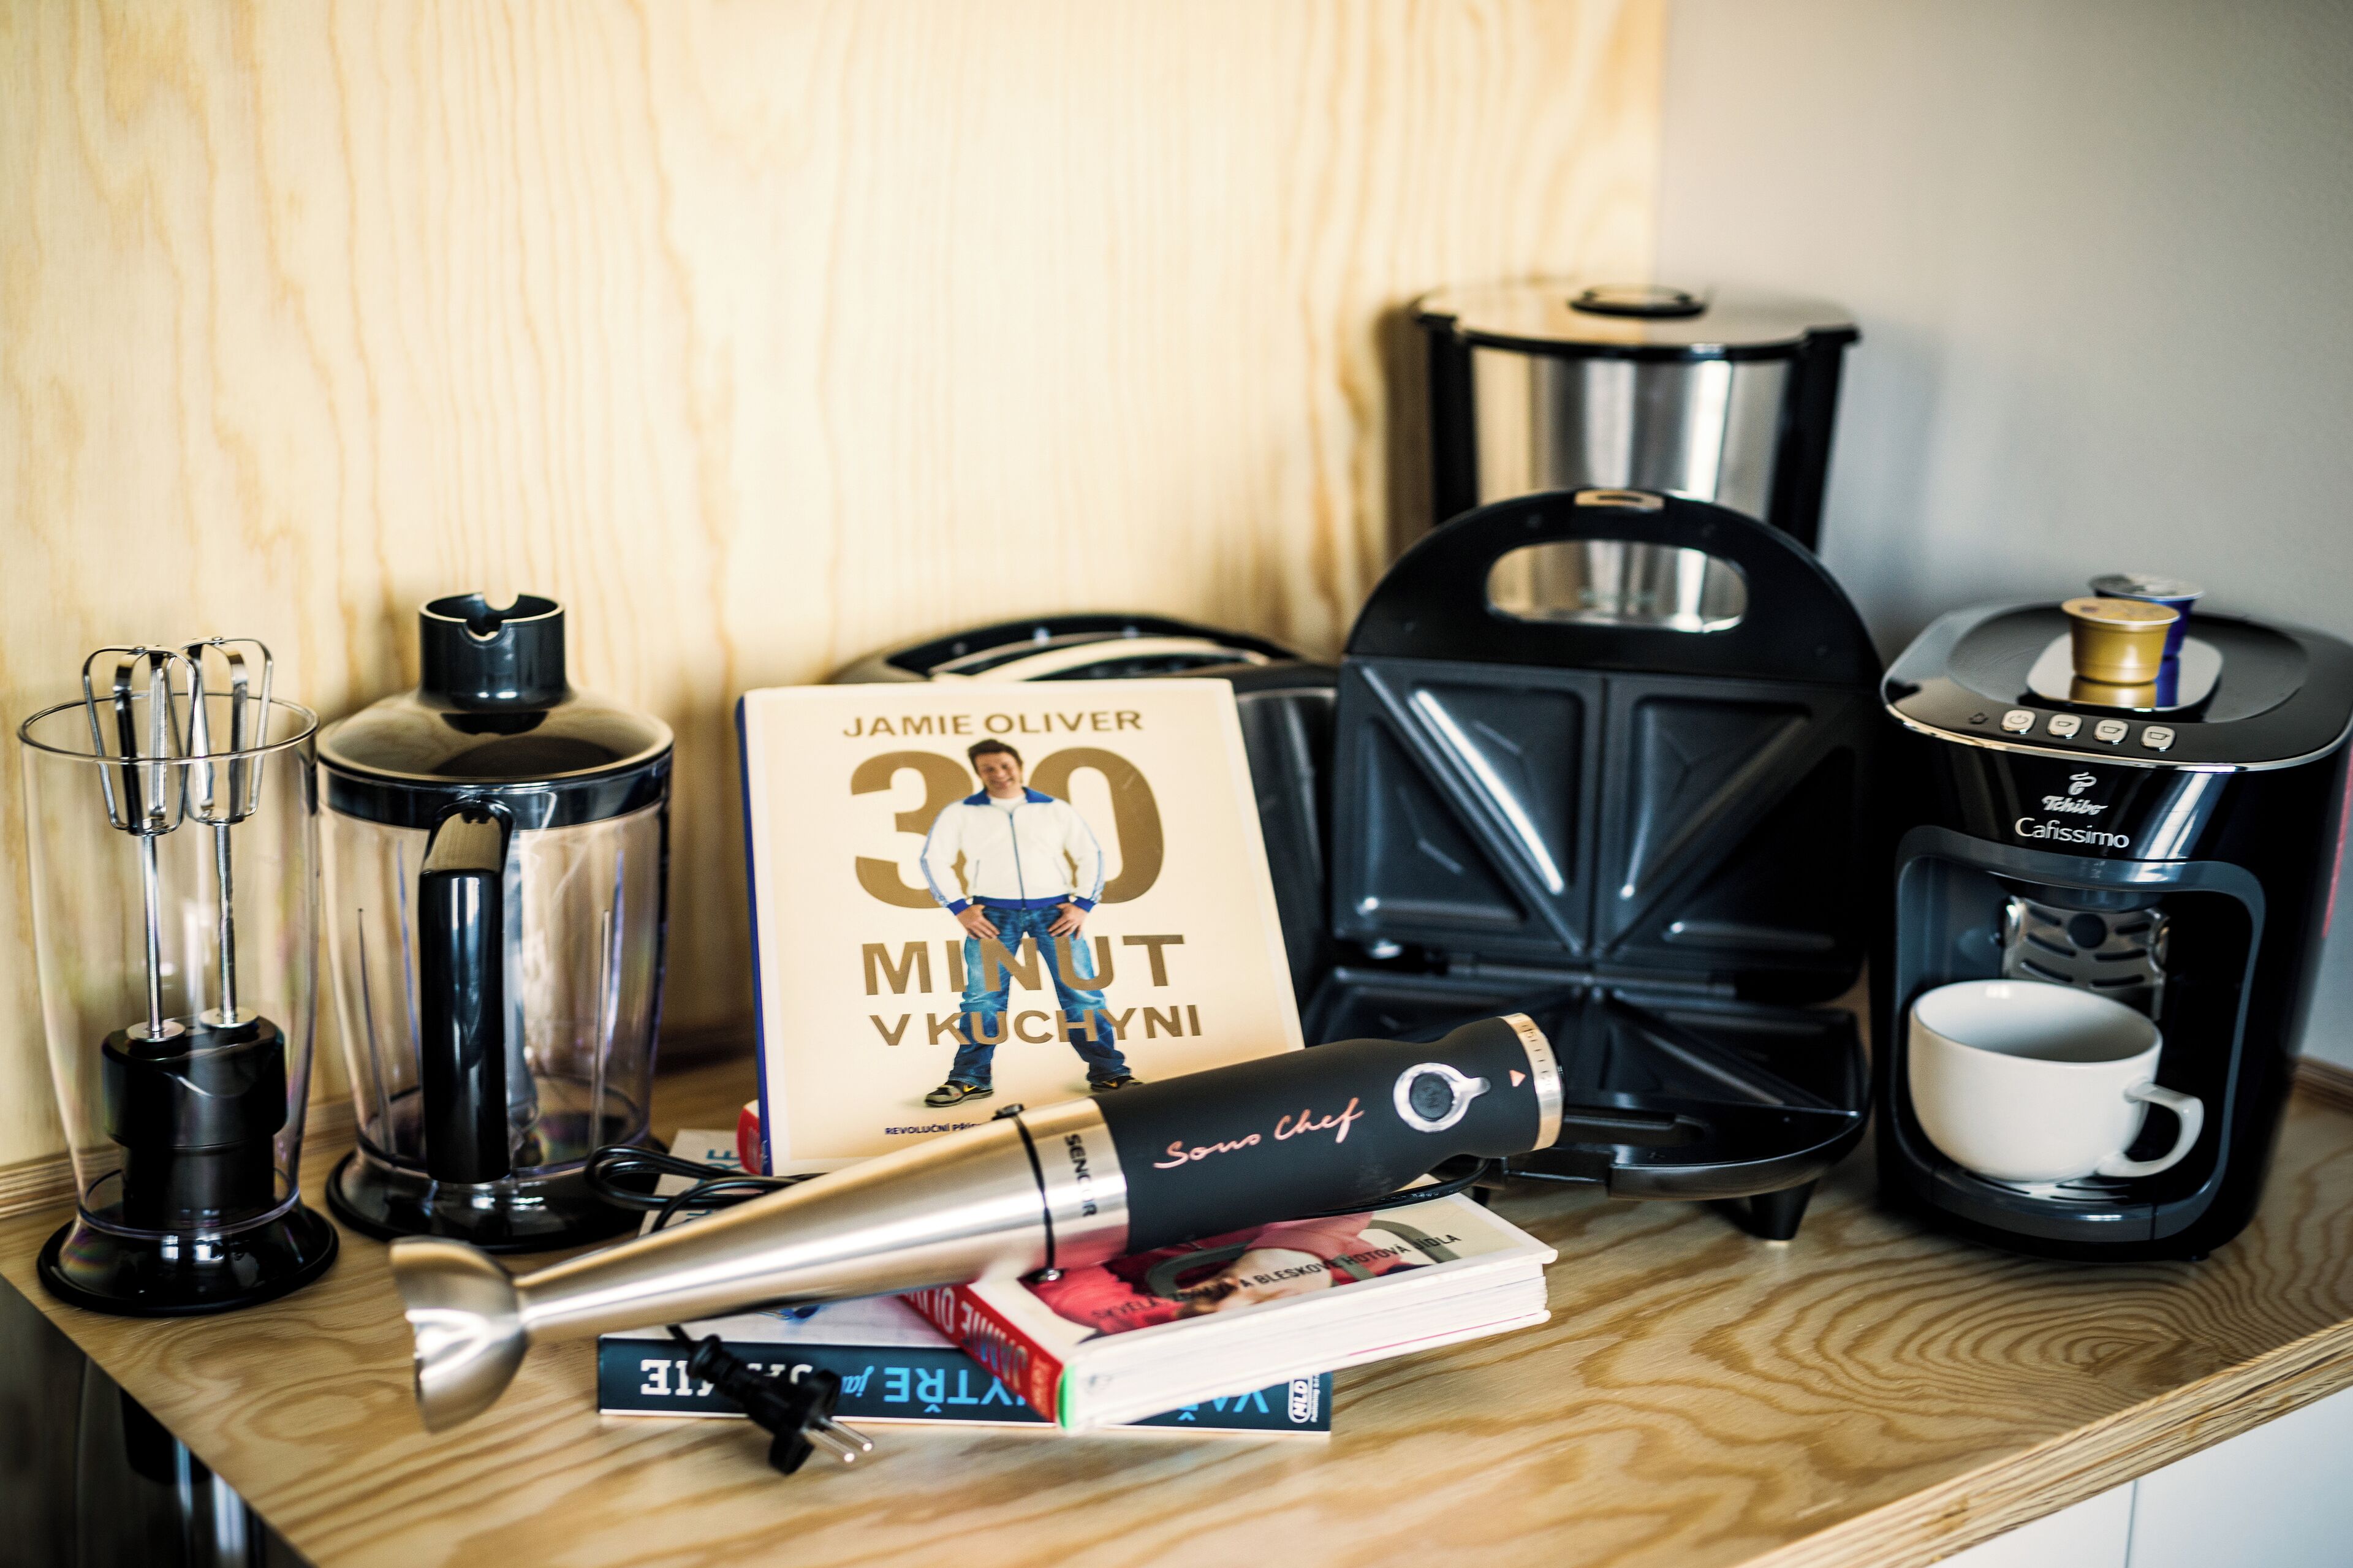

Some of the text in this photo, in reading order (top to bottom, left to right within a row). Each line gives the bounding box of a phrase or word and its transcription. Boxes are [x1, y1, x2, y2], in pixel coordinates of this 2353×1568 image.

[843, 710, 1143, 737] JAMIE OLIVER
[2041, 795, 2108, 815] Tchibo
[851, 746, 1164, 909] 30
[2015, 817, 2130, 848] Cafissimo
[862, 934, 1185, 996] MINUT
[869, 1004, 1202, 1047] V KUCHYNI
[885, 1123, 950, 1135] REVOLUČNÍ
[1273, 1097, 1365, 1143] Chef
[1341, 1243, 1411, 1265] HOTOVÁ
[1415, 1233, 1462, 1251] JÍDLA
